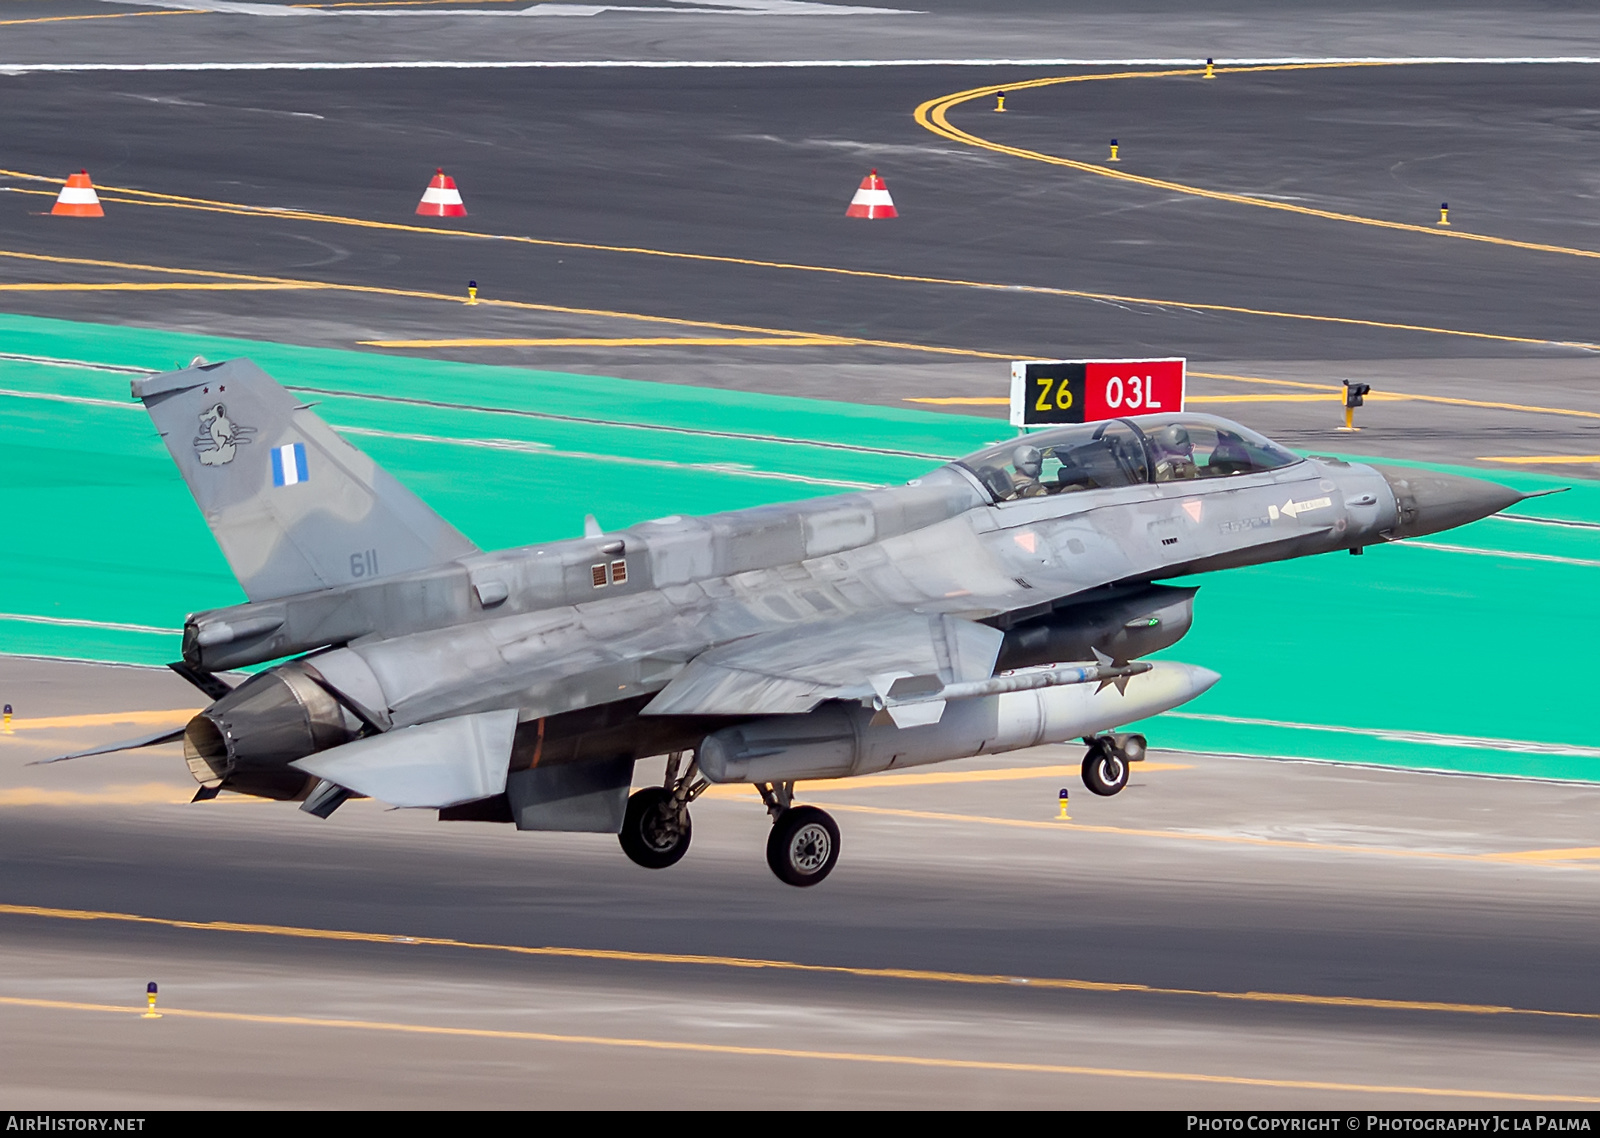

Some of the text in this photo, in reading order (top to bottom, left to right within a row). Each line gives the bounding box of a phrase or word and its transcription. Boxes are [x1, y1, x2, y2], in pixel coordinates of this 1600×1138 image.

[1035, 378, 1073, 411] Z6
[1105, 375, 1162, 409] 03L
[350, 548, 379, 578] 611
